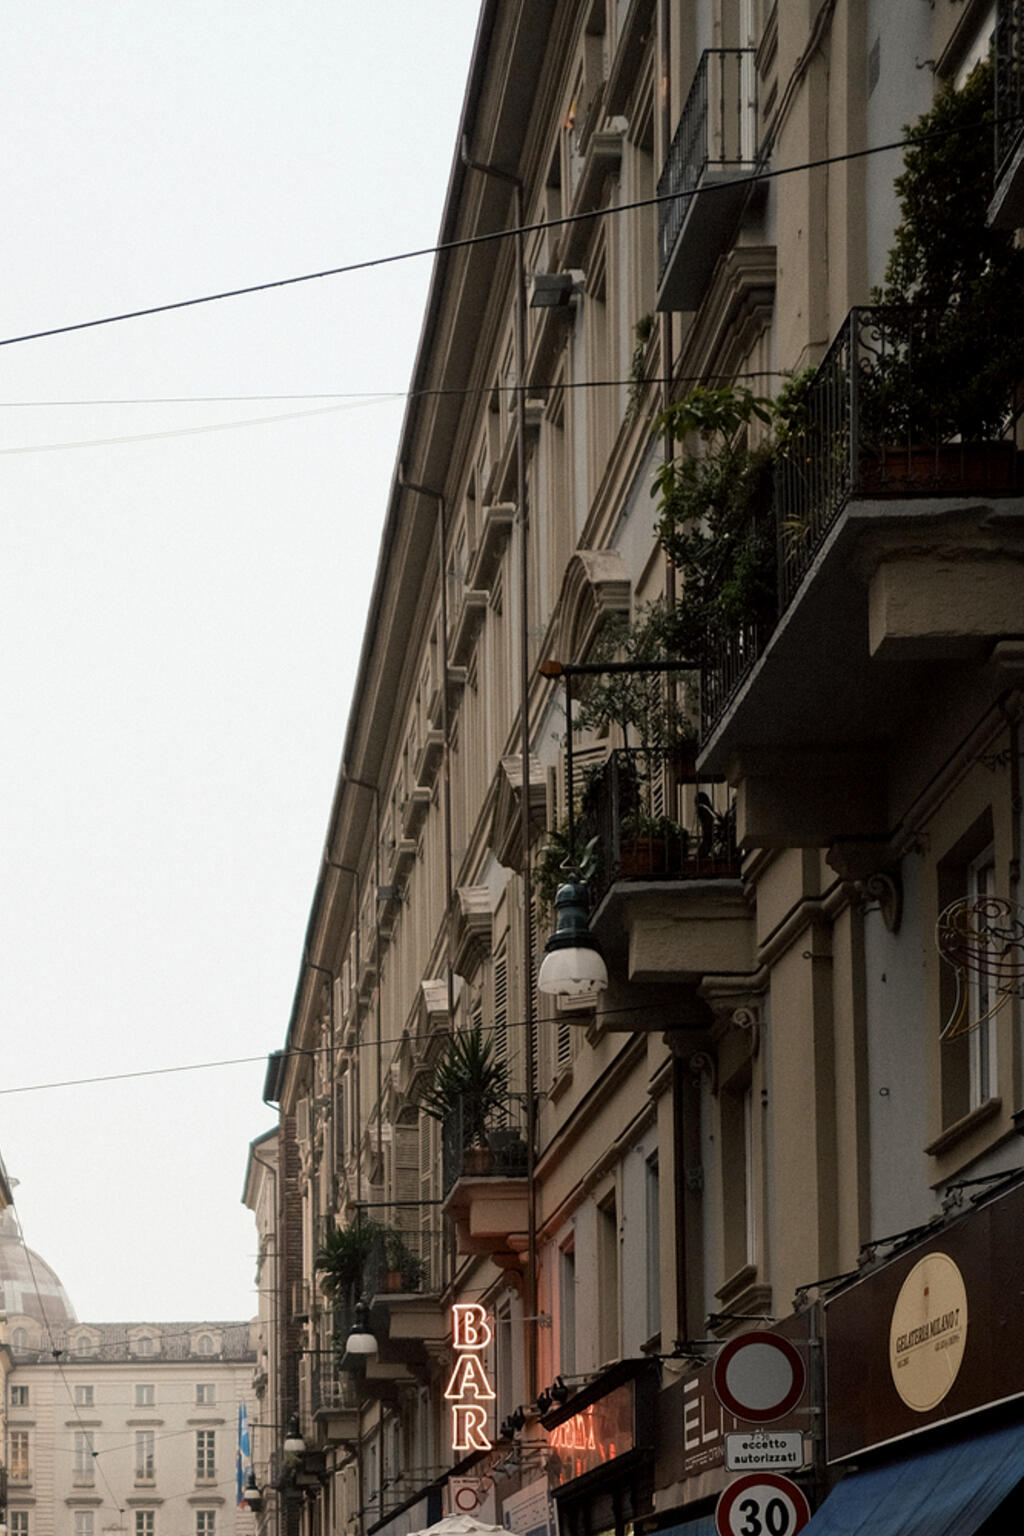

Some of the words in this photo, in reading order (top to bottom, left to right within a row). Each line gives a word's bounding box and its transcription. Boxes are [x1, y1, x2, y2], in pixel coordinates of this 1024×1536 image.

[896, 1323, 929, 1353] GELATERIA
[930, 1310, 955, 1336] MILANO
[445, 1303, 496, 1450] BAR
[734, 1452, 796, 1464] autorizzati
[742, 1440, 787, 1450] eccetto
